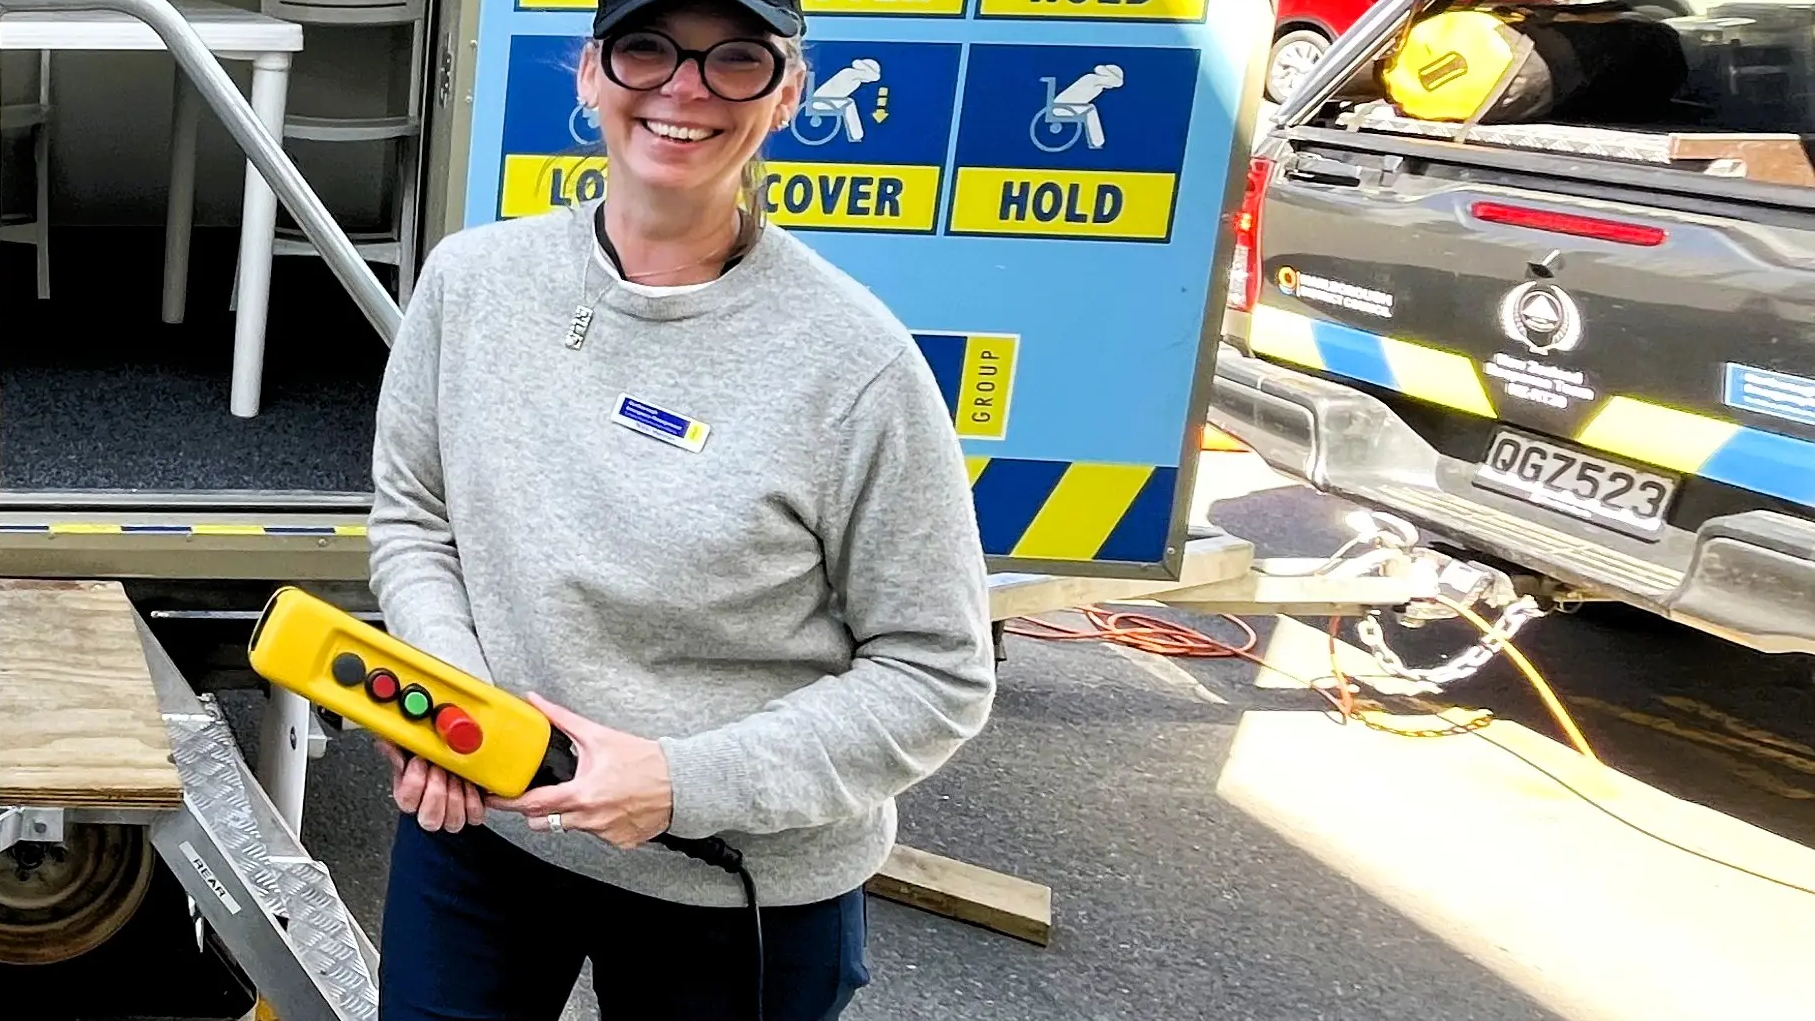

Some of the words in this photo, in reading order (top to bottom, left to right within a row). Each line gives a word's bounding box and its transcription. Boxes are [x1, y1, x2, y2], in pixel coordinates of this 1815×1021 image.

[550, 168, 605, 206] LO
[759, 173, 904, 217] COVER
[999, 181, 1124, 224] HOLD
[972, 350, 1000, 423] GROUP
[1492, 438, 1667, 520] QGZ523
[194, 858, 226, 898] REAR
